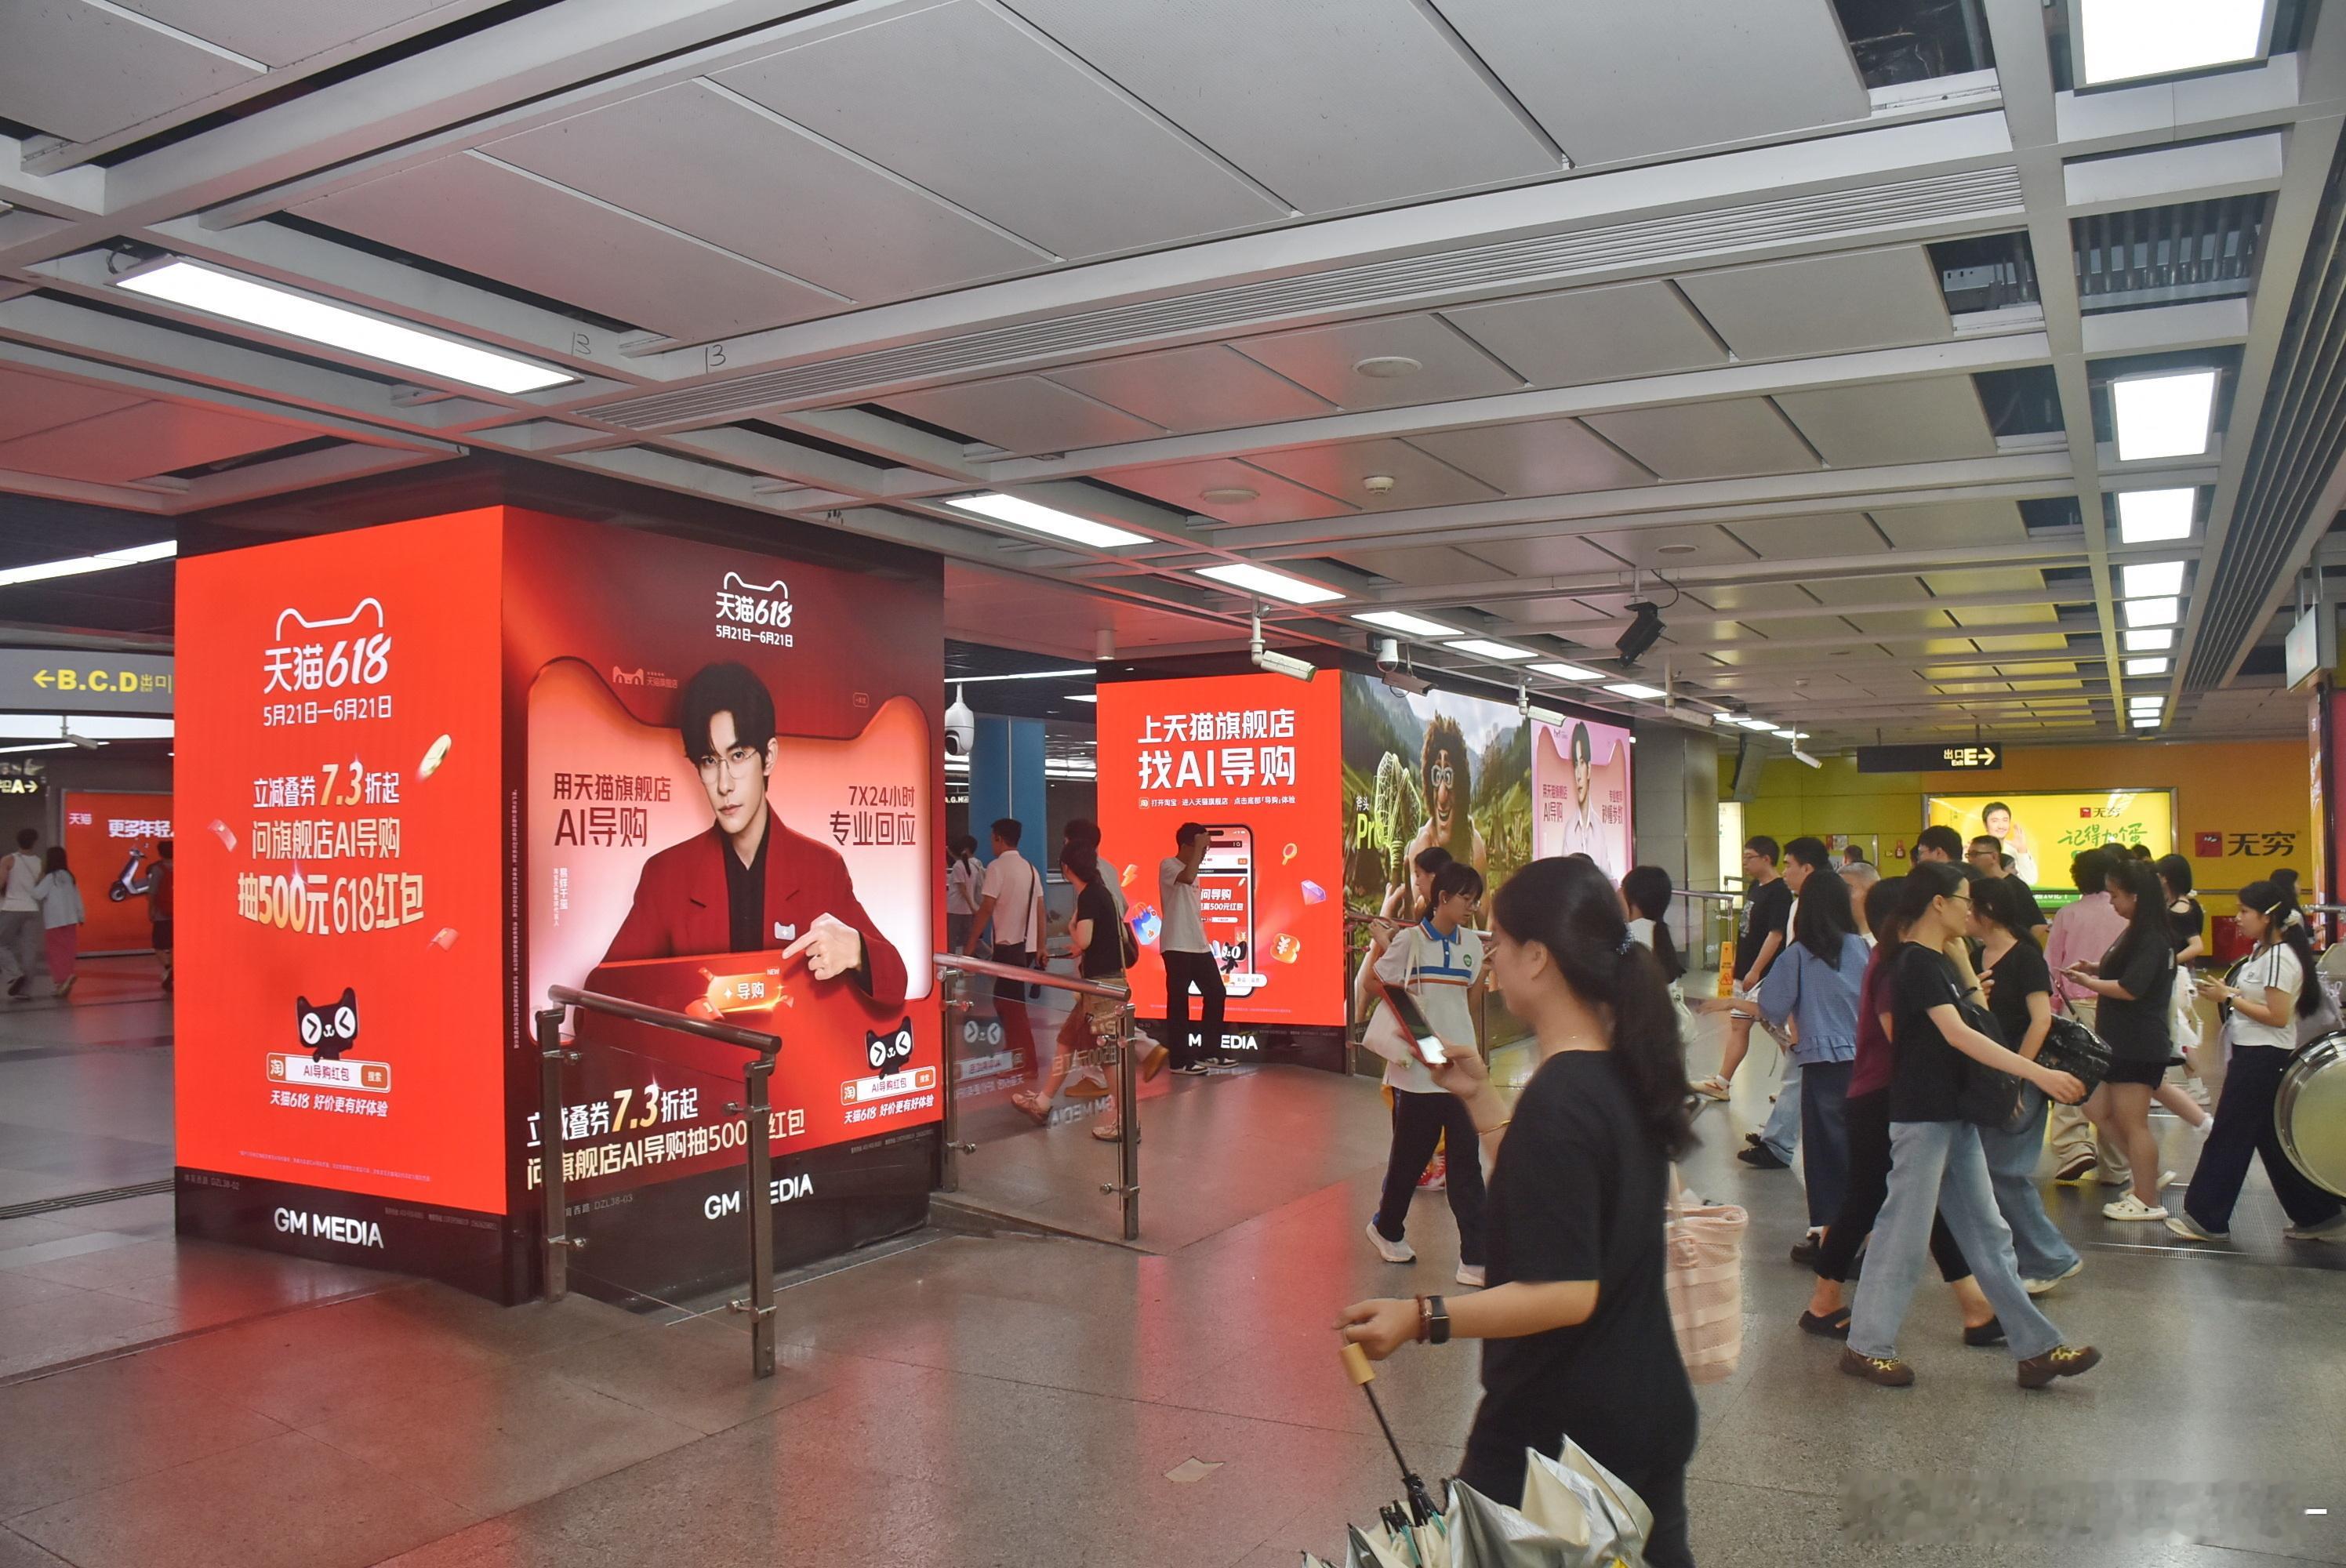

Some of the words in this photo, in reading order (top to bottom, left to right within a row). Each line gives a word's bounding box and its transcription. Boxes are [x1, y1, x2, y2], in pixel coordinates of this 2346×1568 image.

[716, 592, 793, 628] 天猫618
[263, 633, 392, 695] 天猫618
[57, 669, 139, 692] B.C.D
[1138, 709, 1295, 743] 上天猫旗舰店
[1138, 745, 1295, 789] 找AI导购
[1943, 749, 1963, 760] 出口
[1964, 748, 1978, 765] E
[252, 761, 401, 808] 立减叠券7.3折起
[553, 772, 671, 803] 用天猫旗舰店
[848, 786, 915, 809] 7X24小时
[252, 817, 401, 860] 问旗舰店AI导购
[554, 807, 648, 848] AI导购
[829, 810, 917, 847] 专业回应
[2228, 831, 2297, 857] 无穷
[737, 982, 764, 1000] 导购
[1221, 1034, 1258, 1050] EDIA
[303, 1065, 350, 1082] AI导购红包
[871, 1078, 907, 1093] AI导购红包
[270, 1090, 311, 1109] 天猫618
[313, 1094, 389, 1117] 好价更有好体验
[844, 1105, 877, 1124] 天猫618
[879, 1094, 935, 1117] 好价更有好体验
[704, 1190, 740, 1220] GM
[274, 1207, 308, 1236] GM
[313, 1214, 384, 1248] MEDIA
